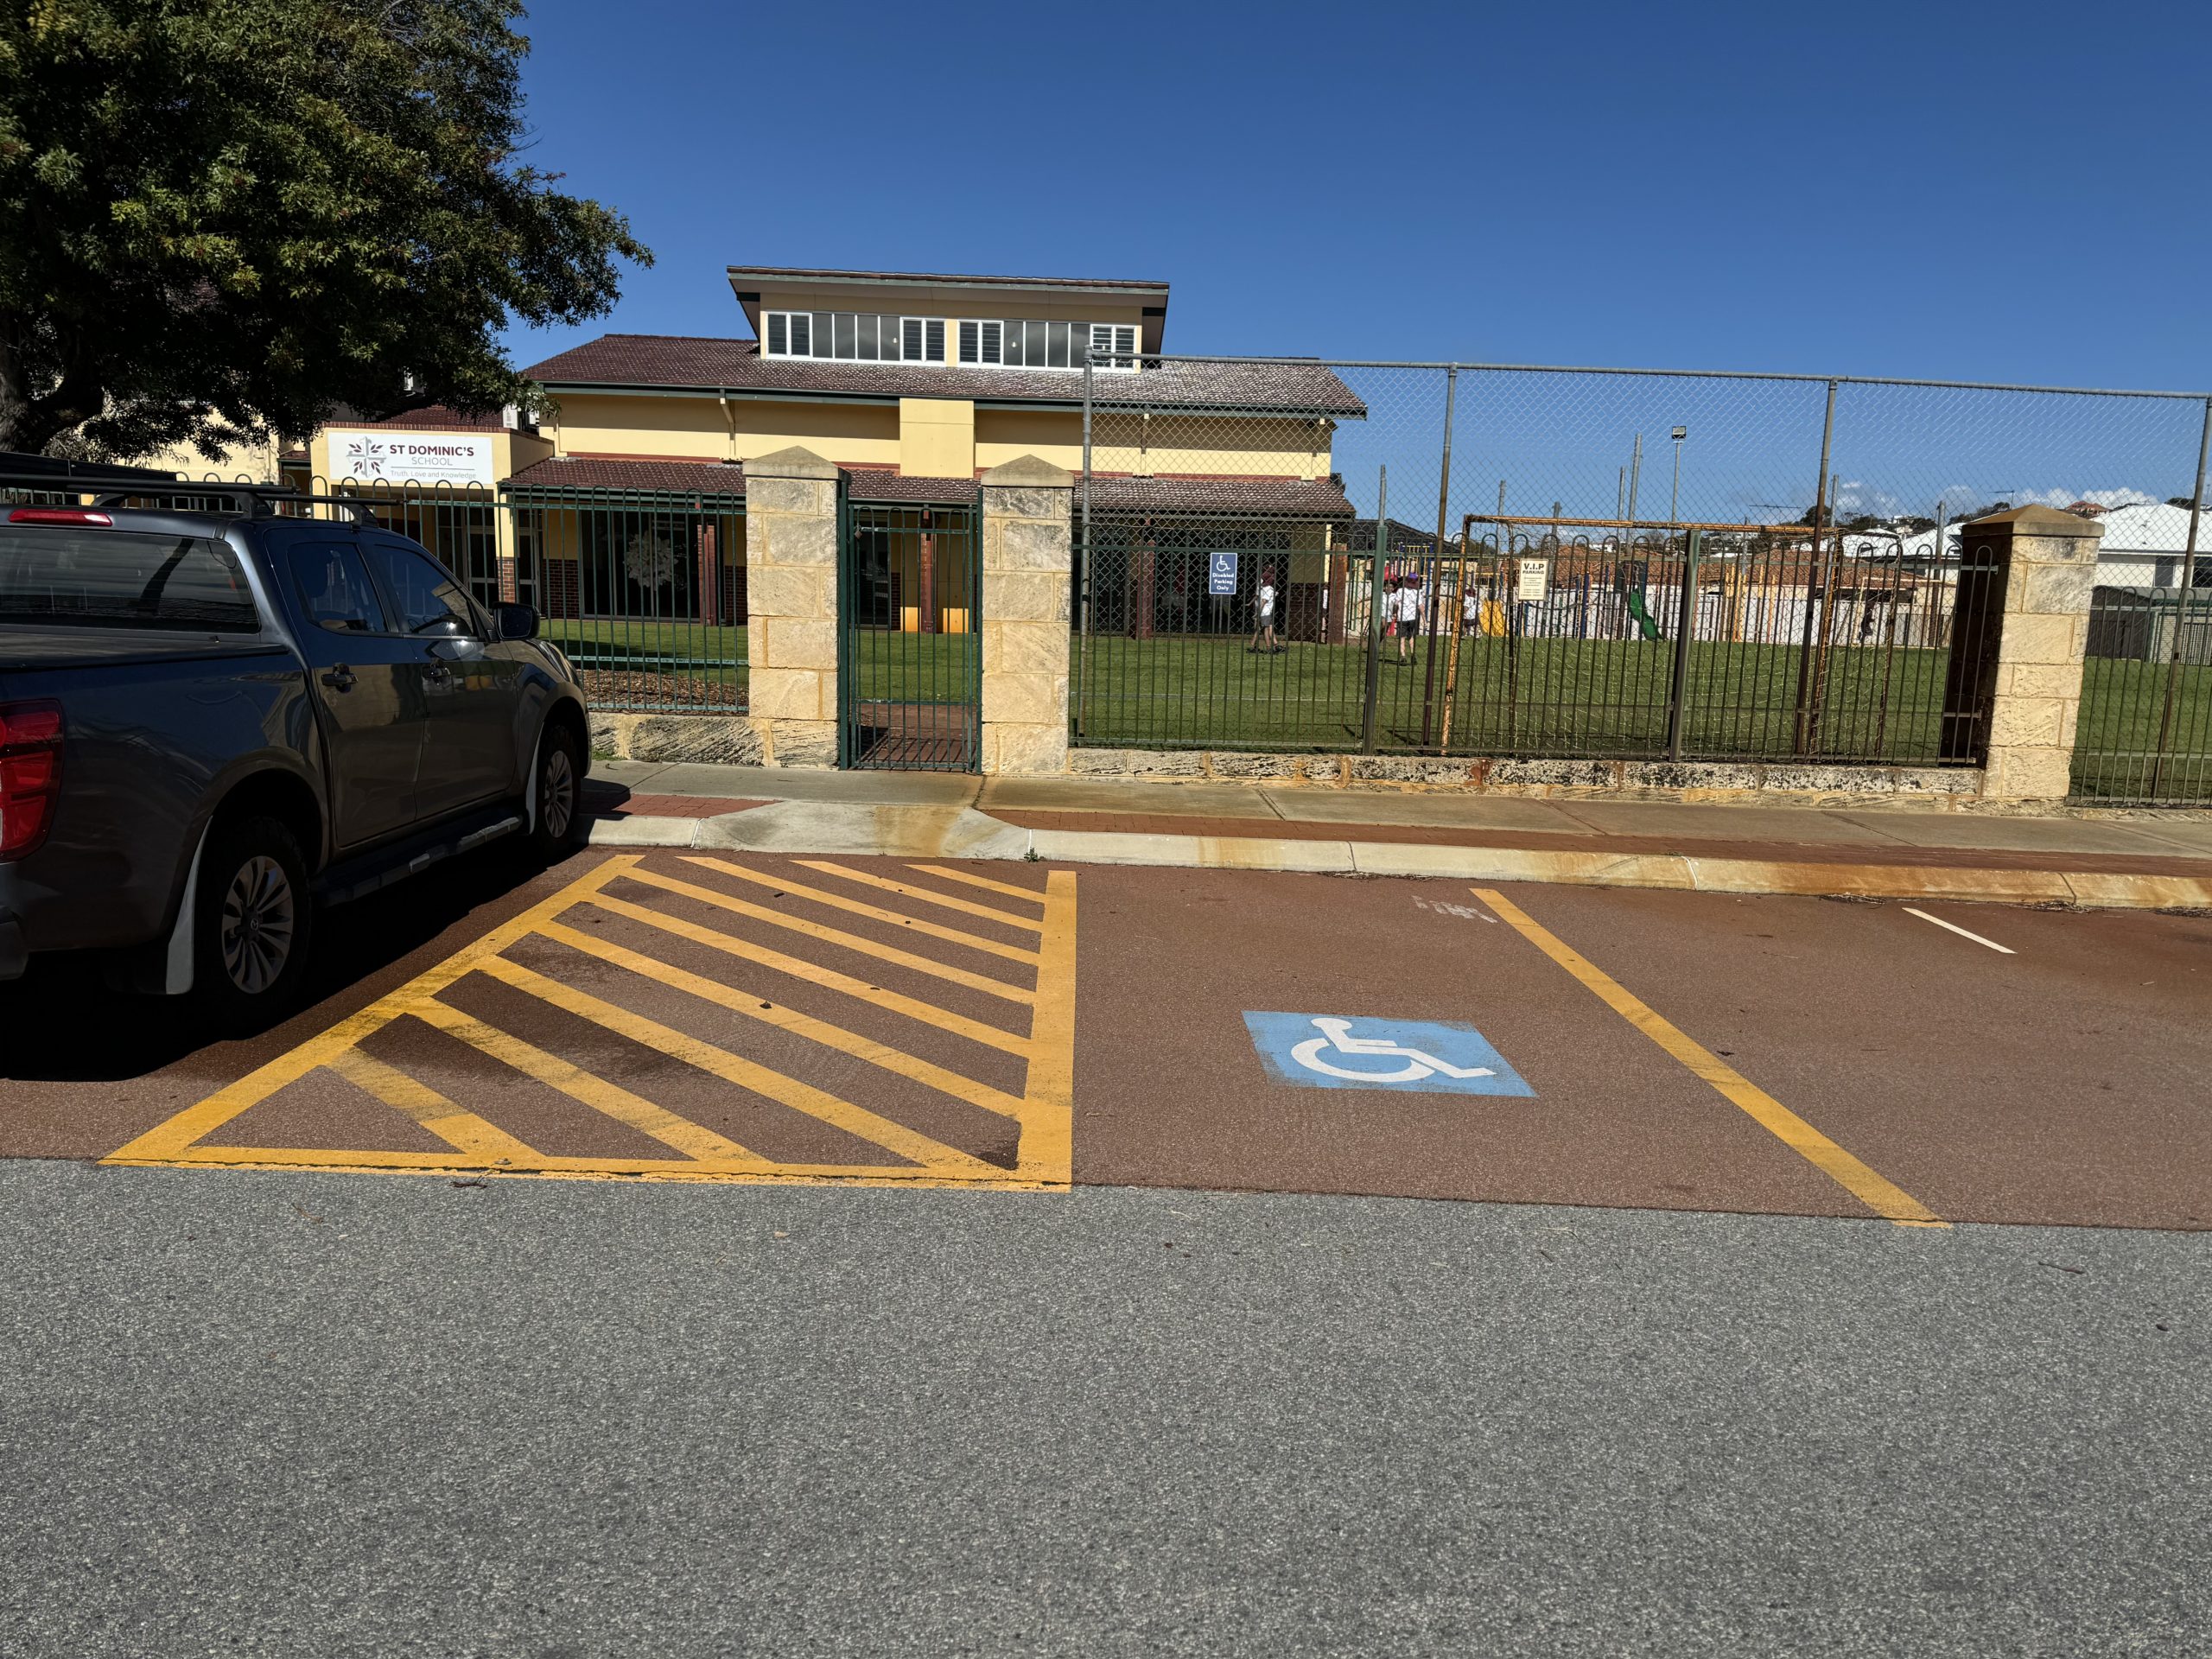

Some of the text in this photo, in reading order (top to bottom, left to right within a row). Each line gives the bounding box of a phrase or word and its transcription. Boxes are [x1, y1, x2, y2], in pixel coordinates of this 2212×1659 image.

[390, 445, 474, 456] ST DOMINIC'S
[411, 456, 453, 466] SCHOOL
